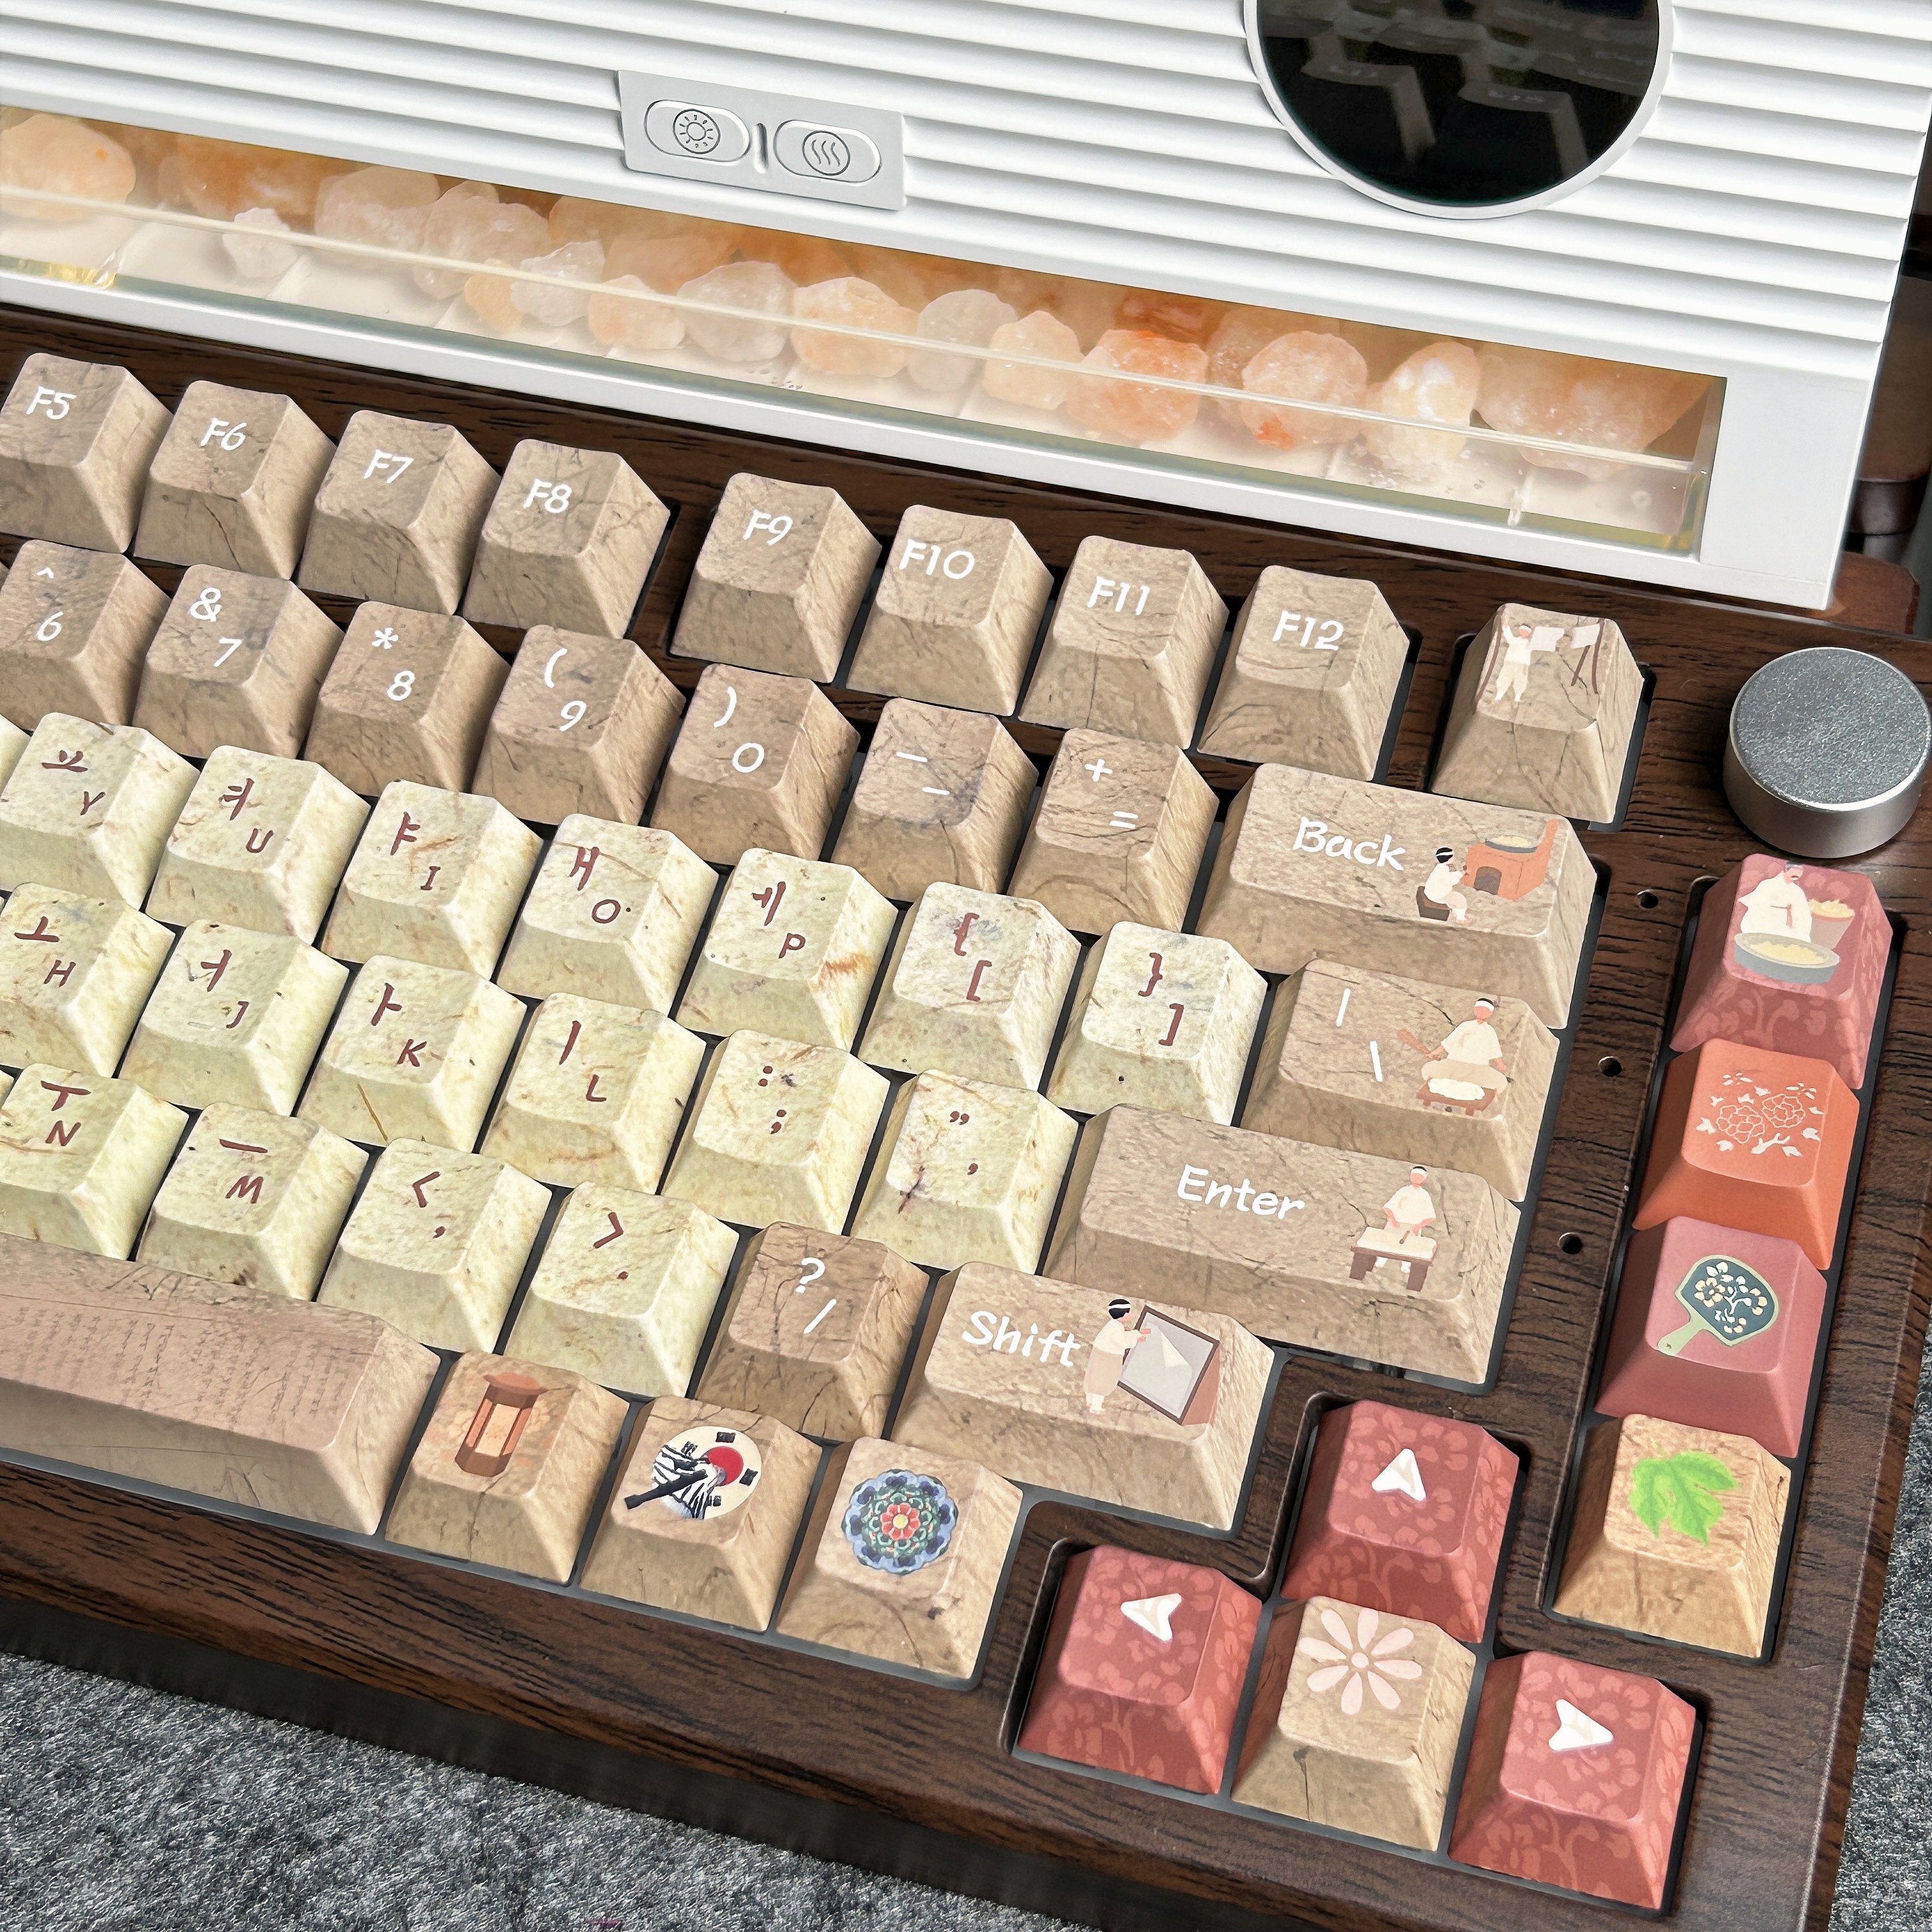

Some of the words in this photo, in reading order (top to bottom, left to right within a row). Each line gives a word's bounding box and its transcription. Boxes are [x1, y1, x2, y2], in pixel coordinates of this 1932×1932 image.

[26, 385, 77, 420] F5
[200, 417, 247, 451] F6
[363, 449, 414, 484] F7
[523, 478, 572, 514] F8
[742, 509, 793, 546] F9
[899, 539, 976, 579] F10
[188, 586, 222, 622] &
[1086, 576, 1151, 615] F11
[35, 611, 64, 641] 6
[1272, 610, 1344, 651] F12
[213, 637, 243, 667] 7
[544, 648, 568, 689] (
[386, 670, 415, 701] 8
[559, 700, 587, 732] 9
[713, 686, 737, 728] )
[41, 750, 88, 773] ㅛ
[1084, 758, 1113, 783] +
[80, 791, 106, 816] Y
[220, 778, 255, 821] ㅕ
[390, 811, 421, 856] ㅑ
[1109, 811, 1138, 829] =
[245, 827, 274, 854] U
[1292, 816, 1406, 871] Back
[569, 845, 601, 891] ㅐ
[591, 899, 622, 924] O
[752, 881, 786, 926] ㅔ
[778, 933, 806, 959] P
[953, 912, 980, 957] {
[43, 959, 76, 988] H
[200, 949, 233, 992] ㅓ
[966, 960, 992, 1002] [
[1138, 952, 1163, 997] }
[226, 1000, 250, 1029] J
[1158, 1002, 1184, 1046] ]
[395, 1038, 427, 1068] K
[585, 1074, 607, 1102] L
[757, 1065, 774, 1087] :
[45, 1120, 82, 1147] N
[770, 1109, 787, 1135] ;
[225, 1175, 264, 1204] M
[411, 1171, 440, 1208] <
[1177, 1163, 1305, 1220] Enter
[593, 1211, 624, 1249] >
[795, 1257, 825, 1294] ?
[803, 1298, 837, 1334] /
[962, 1310, 1081, 1367] Shift
